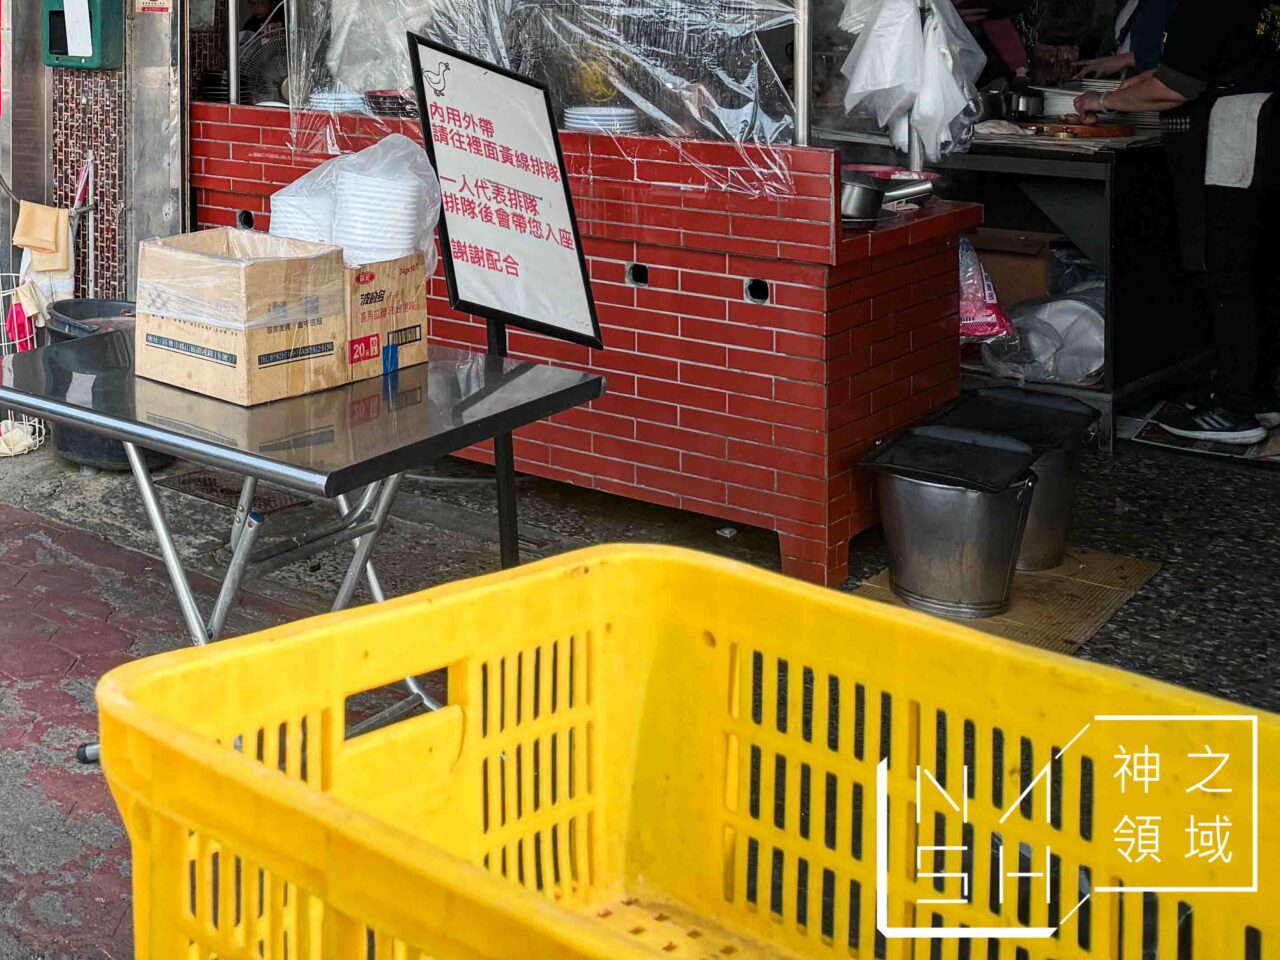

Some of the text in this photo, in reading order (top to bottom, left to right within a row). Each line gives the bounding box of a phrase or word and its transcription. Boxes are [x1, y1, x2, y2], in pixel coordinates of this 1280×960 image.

[431, 124, 561, 183] 請往裡面黃線排隊
[439, 174, 540, 217] 一人代表排隊
[442, 191, 576, 251] 排隊後會帶您入座
[449, 239, 520, 278] 謝謝配合
